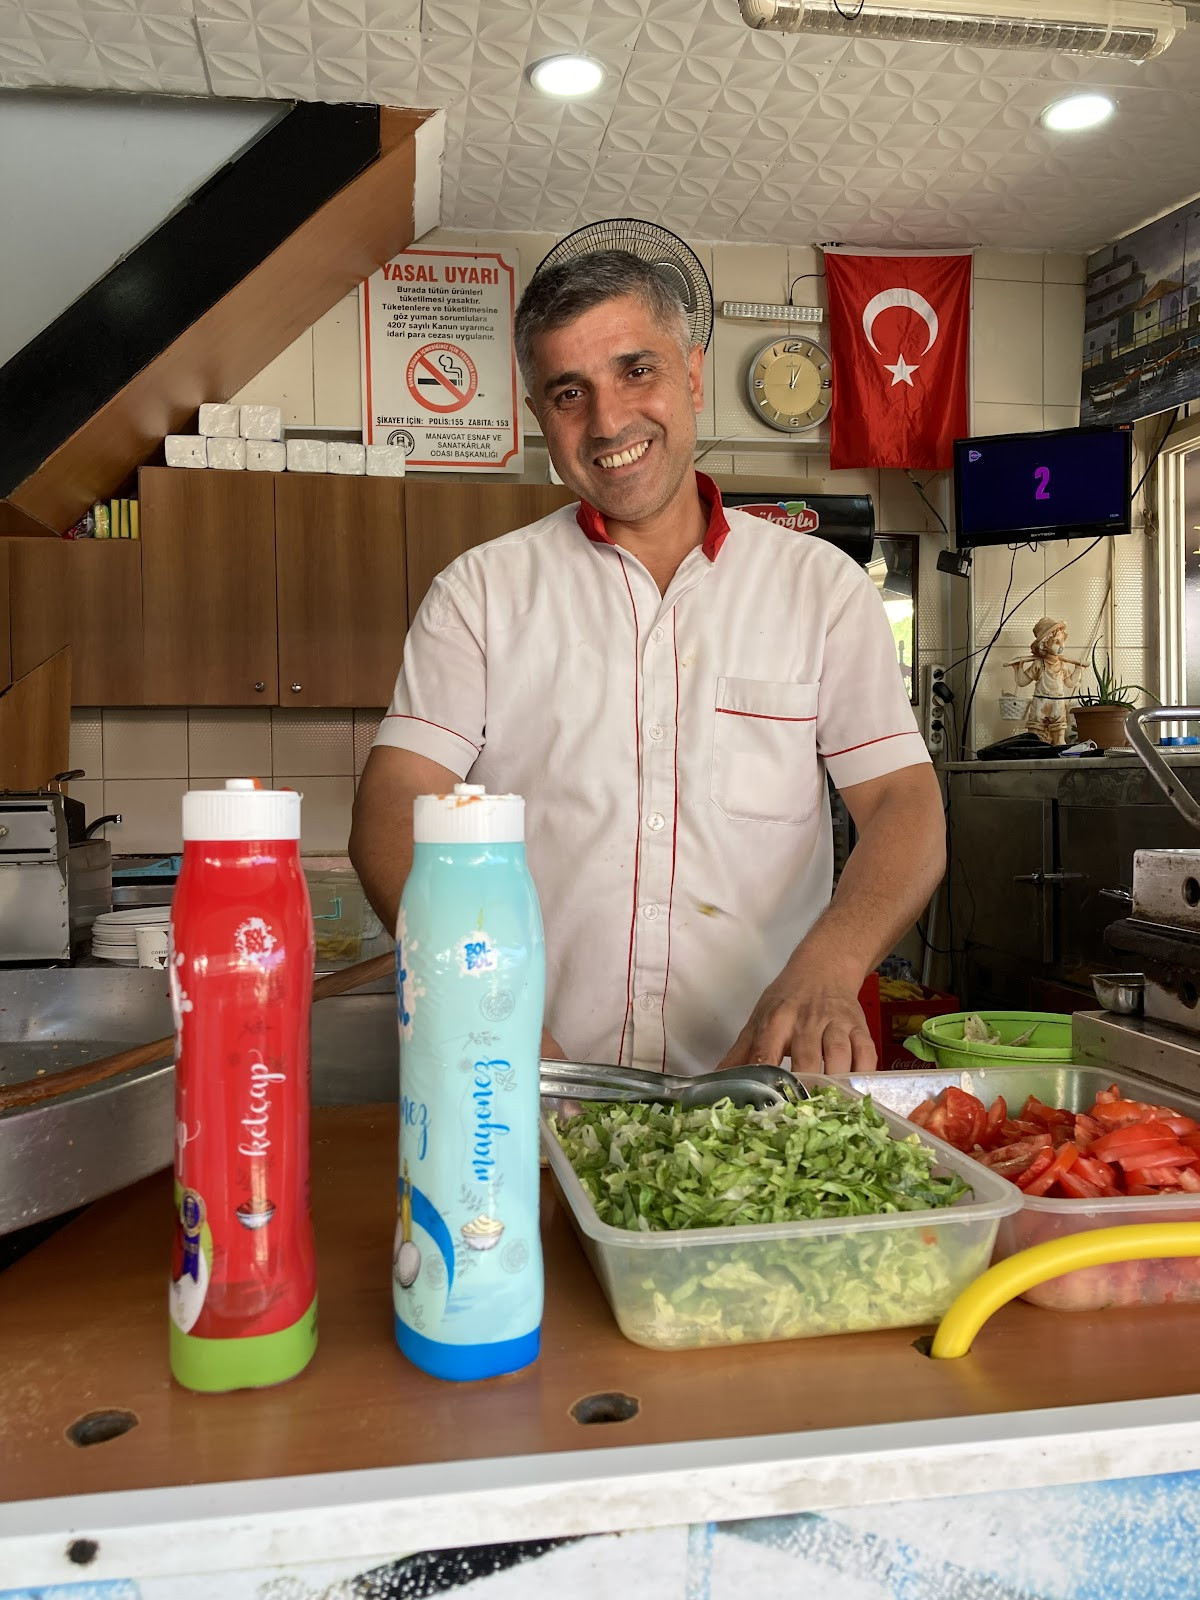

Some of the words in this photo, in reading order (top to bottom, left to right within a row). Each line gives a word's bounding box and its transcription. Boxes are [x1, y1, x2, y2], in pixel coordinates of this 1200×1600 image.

[381, 264, 438, 282] YASAL
[445, 266, 499, 284] UYARI
[397, 286, 426, 294] Burada
[428, 286, 449, 295] tütün
[451, 287, 483, 296] ürünleri
[399, 295, 445, 303] tüketilmesi
[382, 303, 430, 312] Tüketenlere
[444, 305, 499, 314] tüketilmesine
[393, 313, 408, 322] göz
[439, 315, 488, 323] sorumlulara
[408, 322, 430, 331] sayılı
[432, 323, 458, 331] Kanun
[460, 325, 495, 333] uyarınca
[455, 333, 495, 342] uygulanır.
[783, 342, 802, 353] 12
[755, 380, 764, 389] 9
[377, 415, 405, 426] ŞİKAYET
[406, 416, 424, 427] İÇİN:
[468, 418, 494, 427] ZABITA:
[425, 433, 466, 441] MANAVGAT
[467, 433, 490, 441] ESNAF
[1034, 466, 1050, 500] 2
[464, 941, 491, 956] BOL
[238, 1049, 286, 1157] ketçap
[472, 1056, 511, 1182] mayonez
